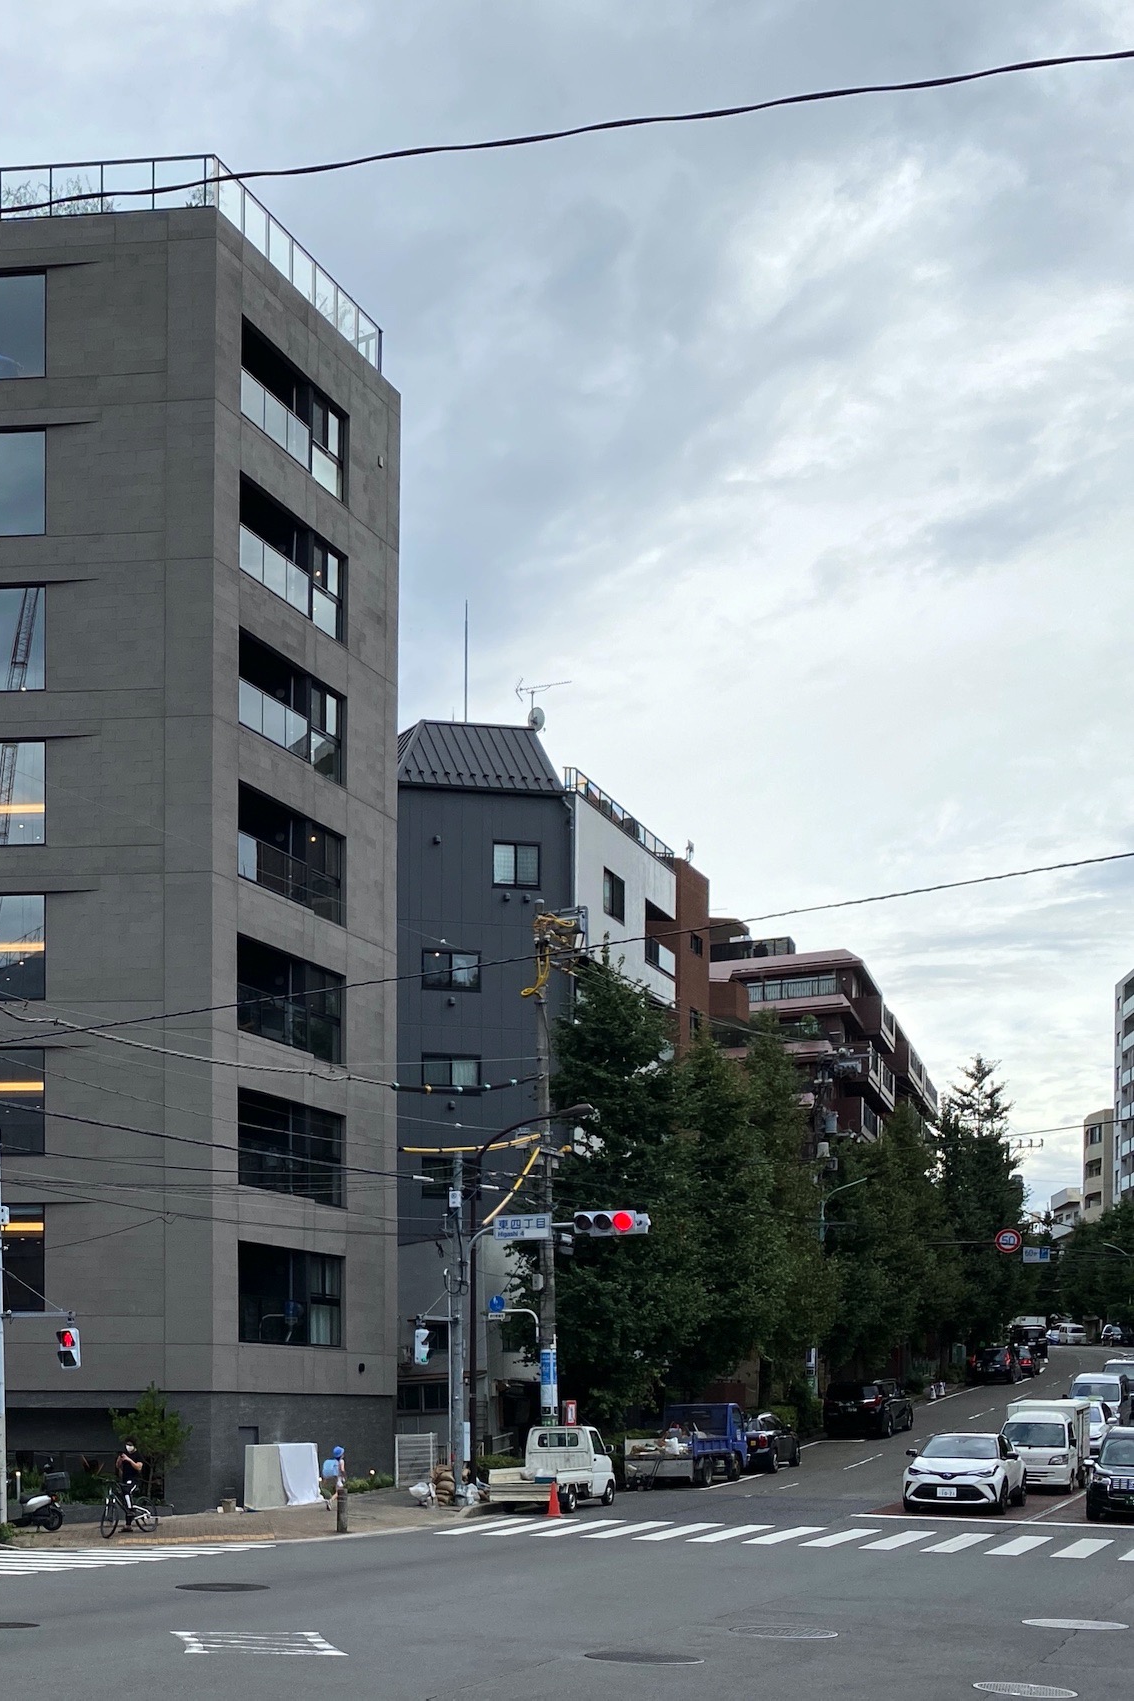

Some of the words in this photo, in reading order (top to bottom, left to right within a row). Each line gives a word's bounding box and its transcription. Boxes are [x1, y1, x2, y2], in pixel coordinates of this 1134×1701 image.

[498, 1217, 546, 1230] 東四丁目
[497, 1230, 519, 1238] Higashi
[1001, 1235, 1016, 1245] 50
